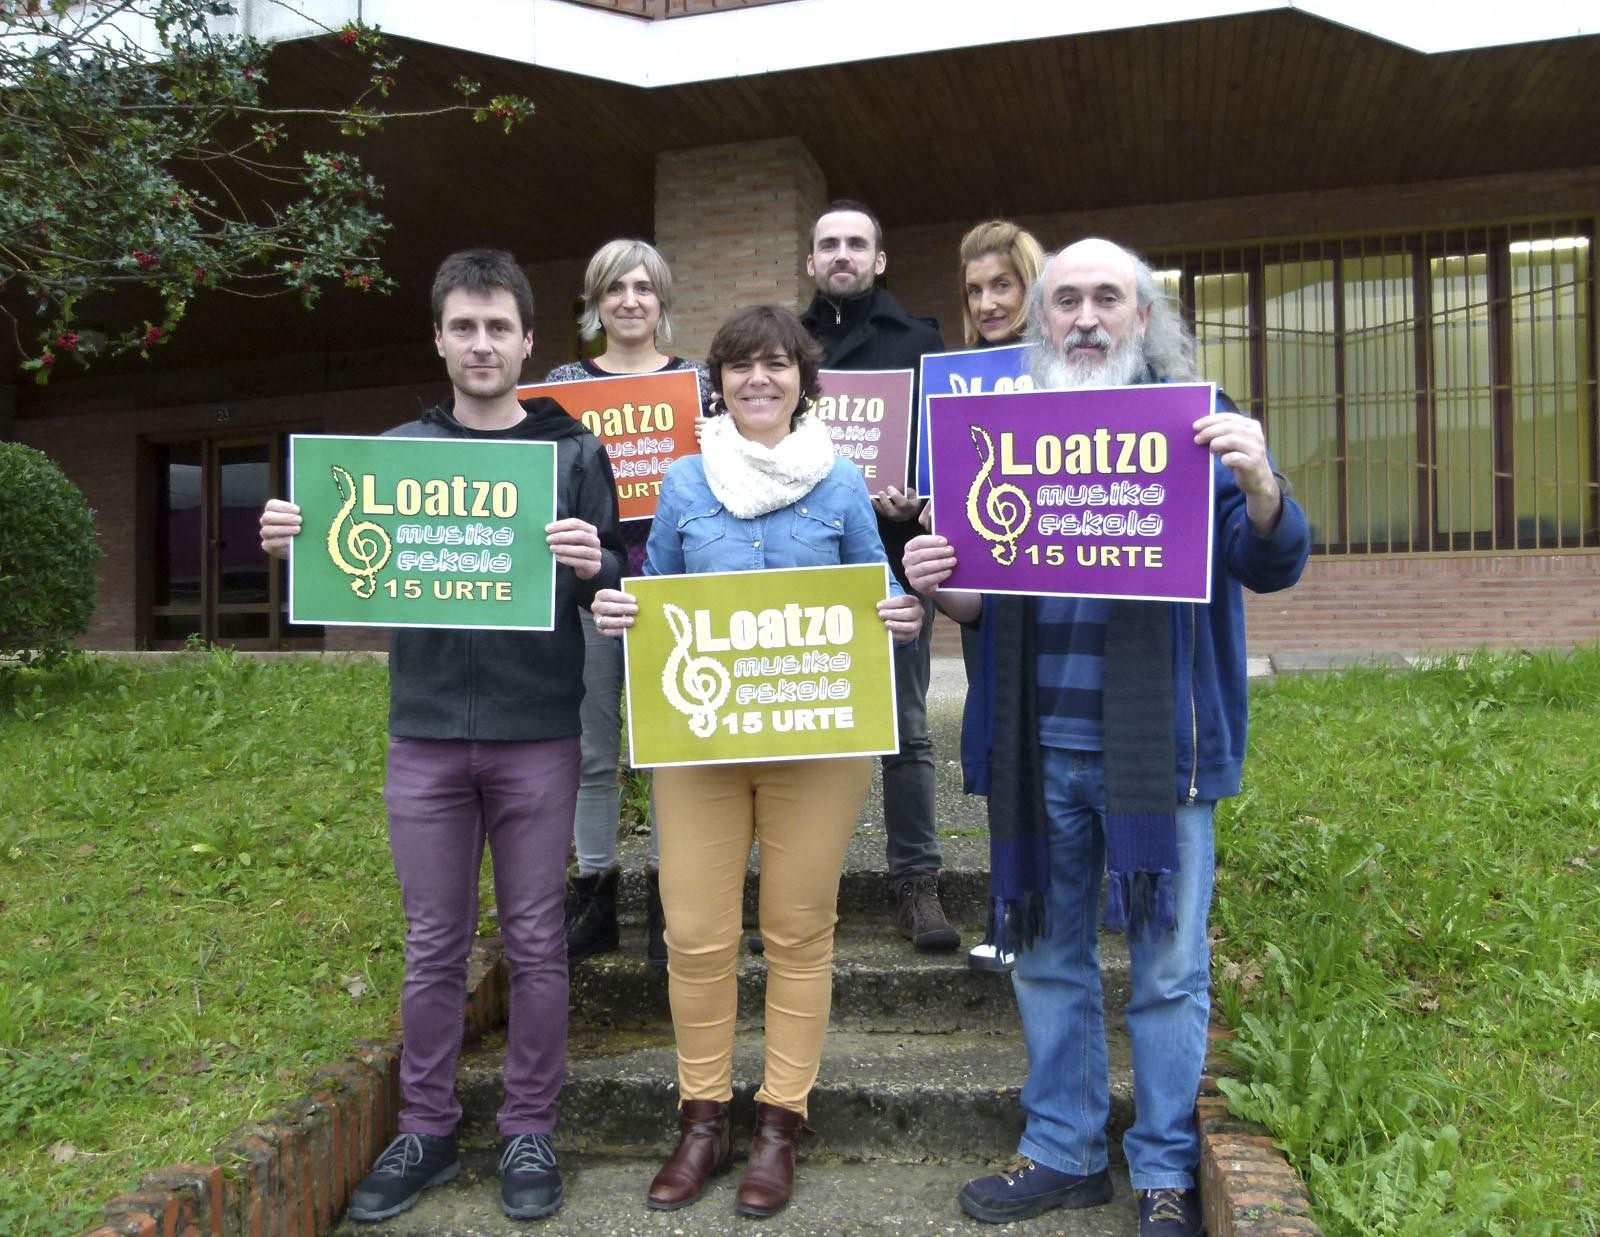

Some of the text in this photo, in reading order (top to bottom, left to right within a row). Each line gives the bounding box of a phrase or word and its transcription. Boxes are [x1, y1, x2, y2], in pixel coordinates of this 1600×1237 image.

[581, 402, 674, 438] oatzo
[827, 425, 881, 442] sika
[606, 437, 675, 458] usika
[1001, 428, 1168, 476] Loatzo
[611, 457, 674, 479] skola
[362, 474, 518, 518] Loatzo
[618, 480, 663, 499] URT
[1037, 481, 1165, 507] musika
[396, 523, 514, 547] musika
[1038, 510, 1163, 537] eskola
[397, 548, 513, 574] eskola
[1024, 544, 1164, 568] 15 URTE
[383, 578, 513, 602] 15 URTE
[695, 603, 853, 652] Loatzo
[734, 651, 850, 676] musika
[736, 677, 850, 704] eskola
[722, 706, 855, 735] 15 URTE
